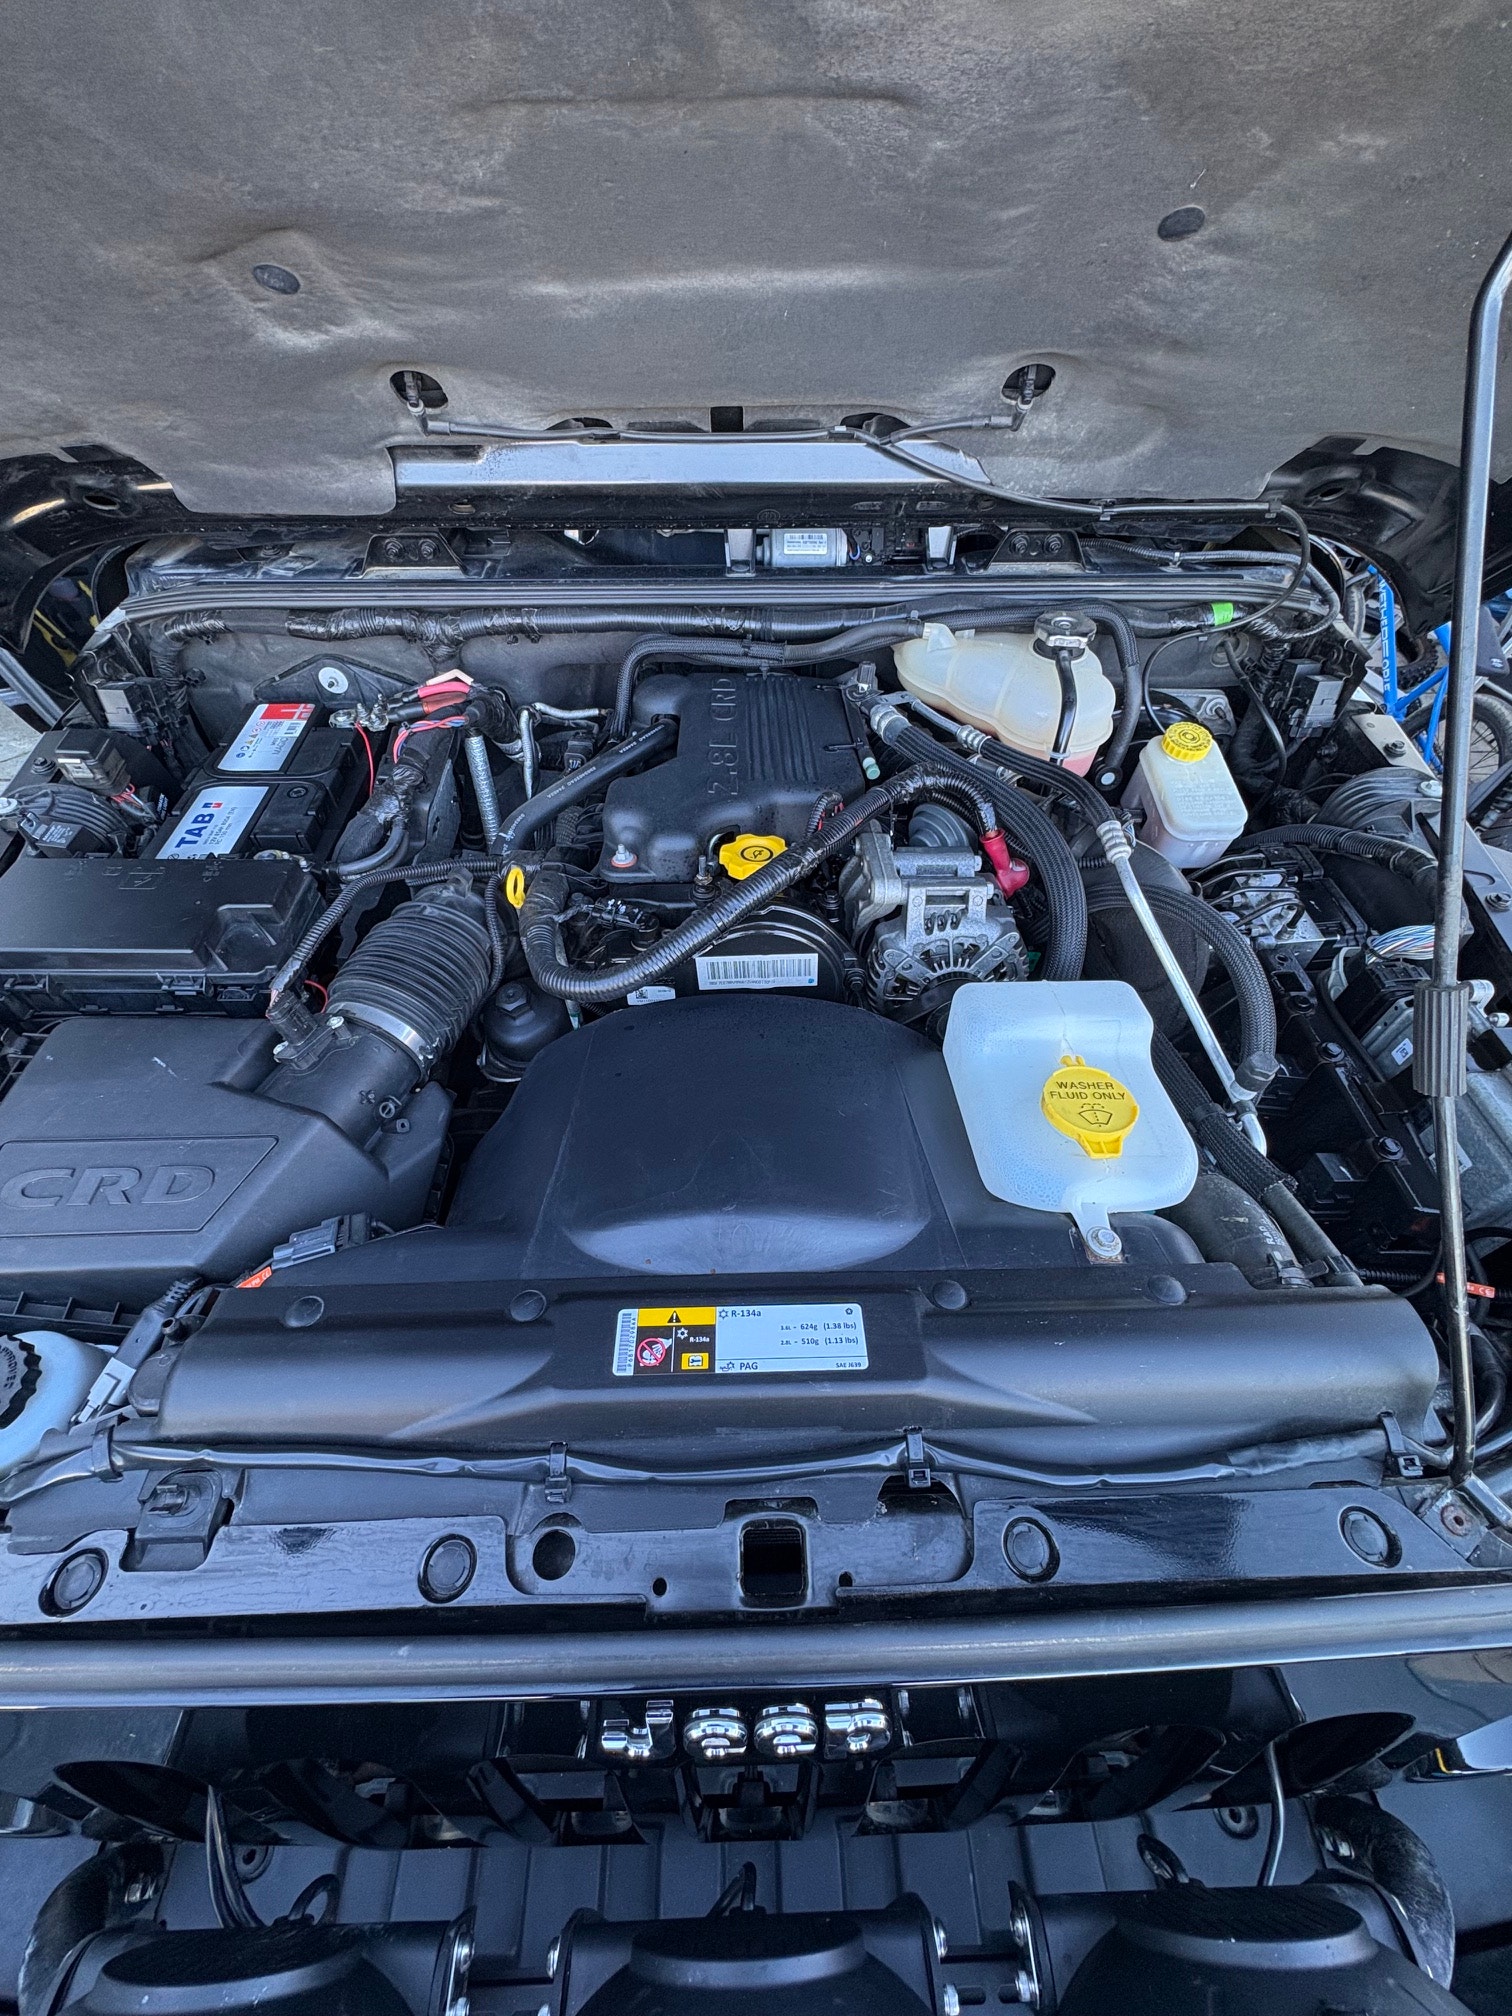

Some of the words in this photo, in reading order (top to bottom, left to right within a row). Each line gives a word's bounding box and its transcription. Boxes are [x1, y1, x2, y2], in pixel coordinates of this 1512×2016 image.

[710, 678, 738, 721] CRD
[707, 732, 739, 795] 2.8L
[174, 813, 215, 848] TAB
[1056, 1081, 1115, 1090] WASHER
[1050, 1091, 1088, 1100] FLUID
[1092, 1091, 1126, 1100] ONLY
[0, 1165, 216, 1209] CRD
[731, 1309, 762, 1318] R-134a
[800, 1323, 818, 1331] 624g
[823, 1322, 841, 1331] (1.38
[843, 1322, 857, 1330] lbs)
[801, 1338, 819, 1346] 510g
[824, 1337, 843, 1346] (1.13
[844, 1336, 858, 1345] lbs)
[739, 1362, 758, 1371] PAG
